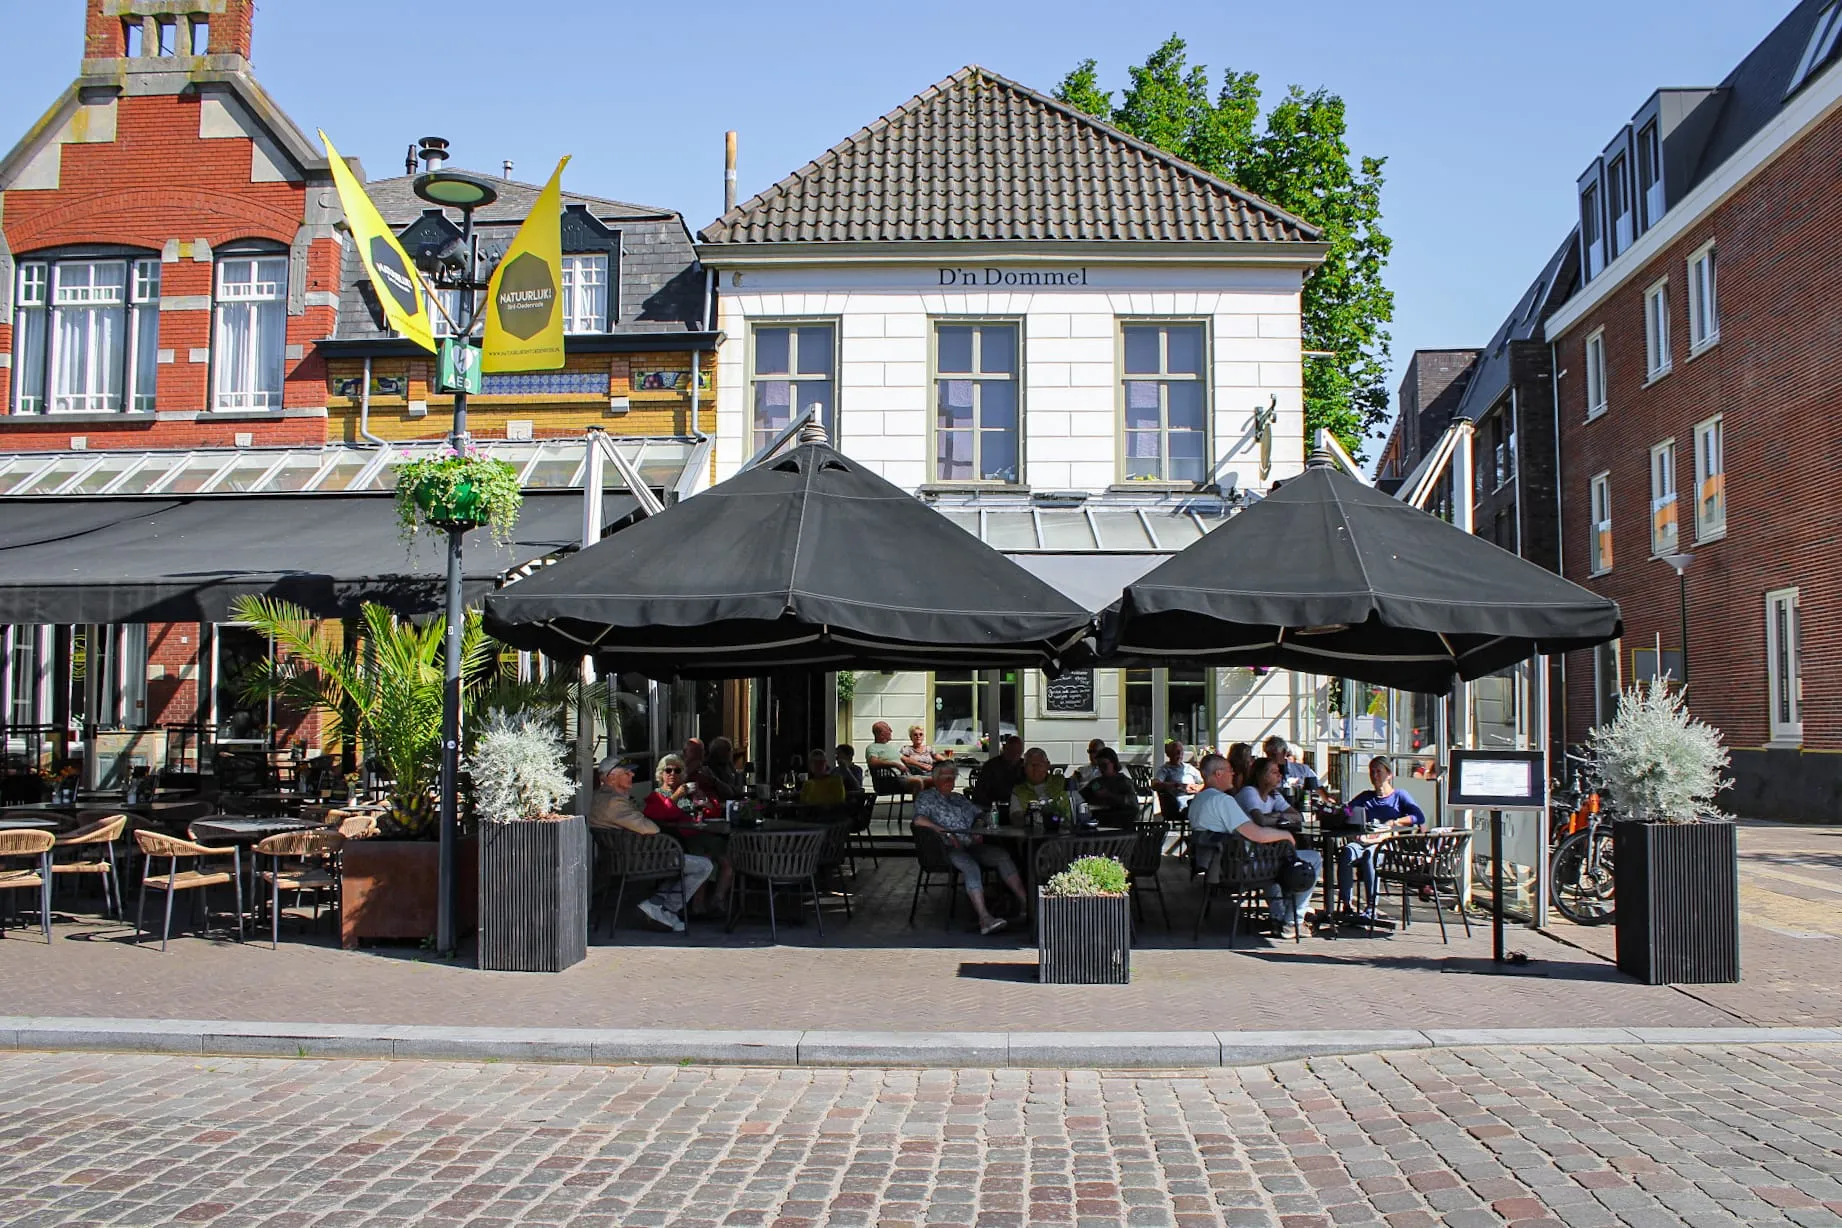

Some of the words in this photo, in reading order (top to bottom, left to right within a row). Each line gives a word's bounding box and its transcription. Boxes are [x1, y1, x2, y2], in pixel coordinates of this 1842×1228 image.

[938, 267, 977, 286] D'n
[984, 267, 1088, 286] Dommel
[448, 373, 472, 390] AED
